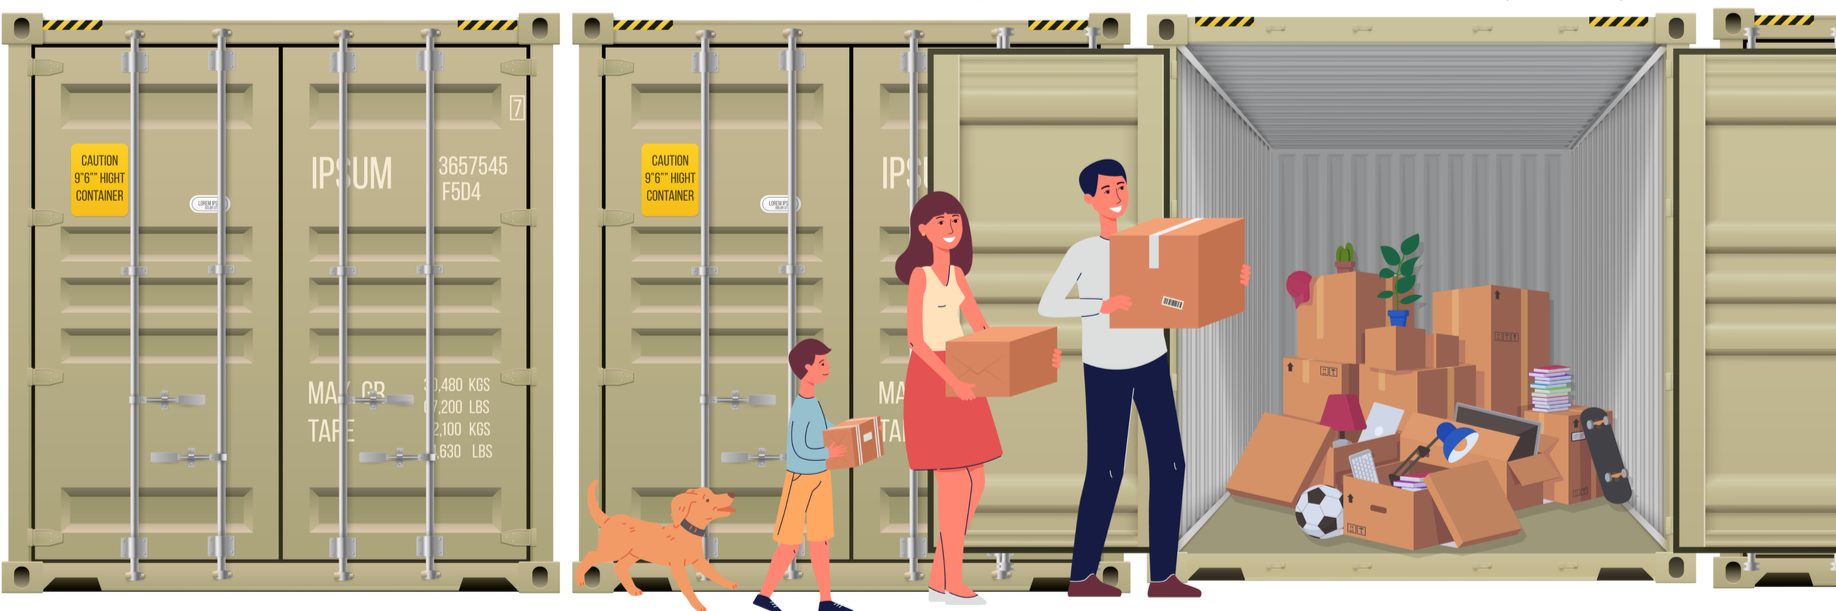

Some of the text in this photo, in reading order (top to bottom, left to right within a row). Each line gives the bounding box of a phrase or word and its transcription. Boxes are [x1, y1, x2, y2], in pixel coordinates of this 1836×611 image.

[513, 99, 522, 117] 7
[81, 154, 119, 166] CAUTION
[438, 156, 508, 175] 3657545
[651, 154, 689, 166] CAUTION
[99, 172, 126, 184] HIGHT
[670, 172, 696, 184] HIGHT
[882, 156, 928, 189] IP
[75, 189, 124, 202] CONTAINER
[442, 182, 481, 201] F5D4
[646, 189, 695, 202] CONTAINER
[468, 377, 491, 392] KGS
[308, 380, 351, 405] MA
[469, 399, 490, 414] LBS
[469, 421, 491, 436] KGS
[472, 443, 493, 459] LBS
